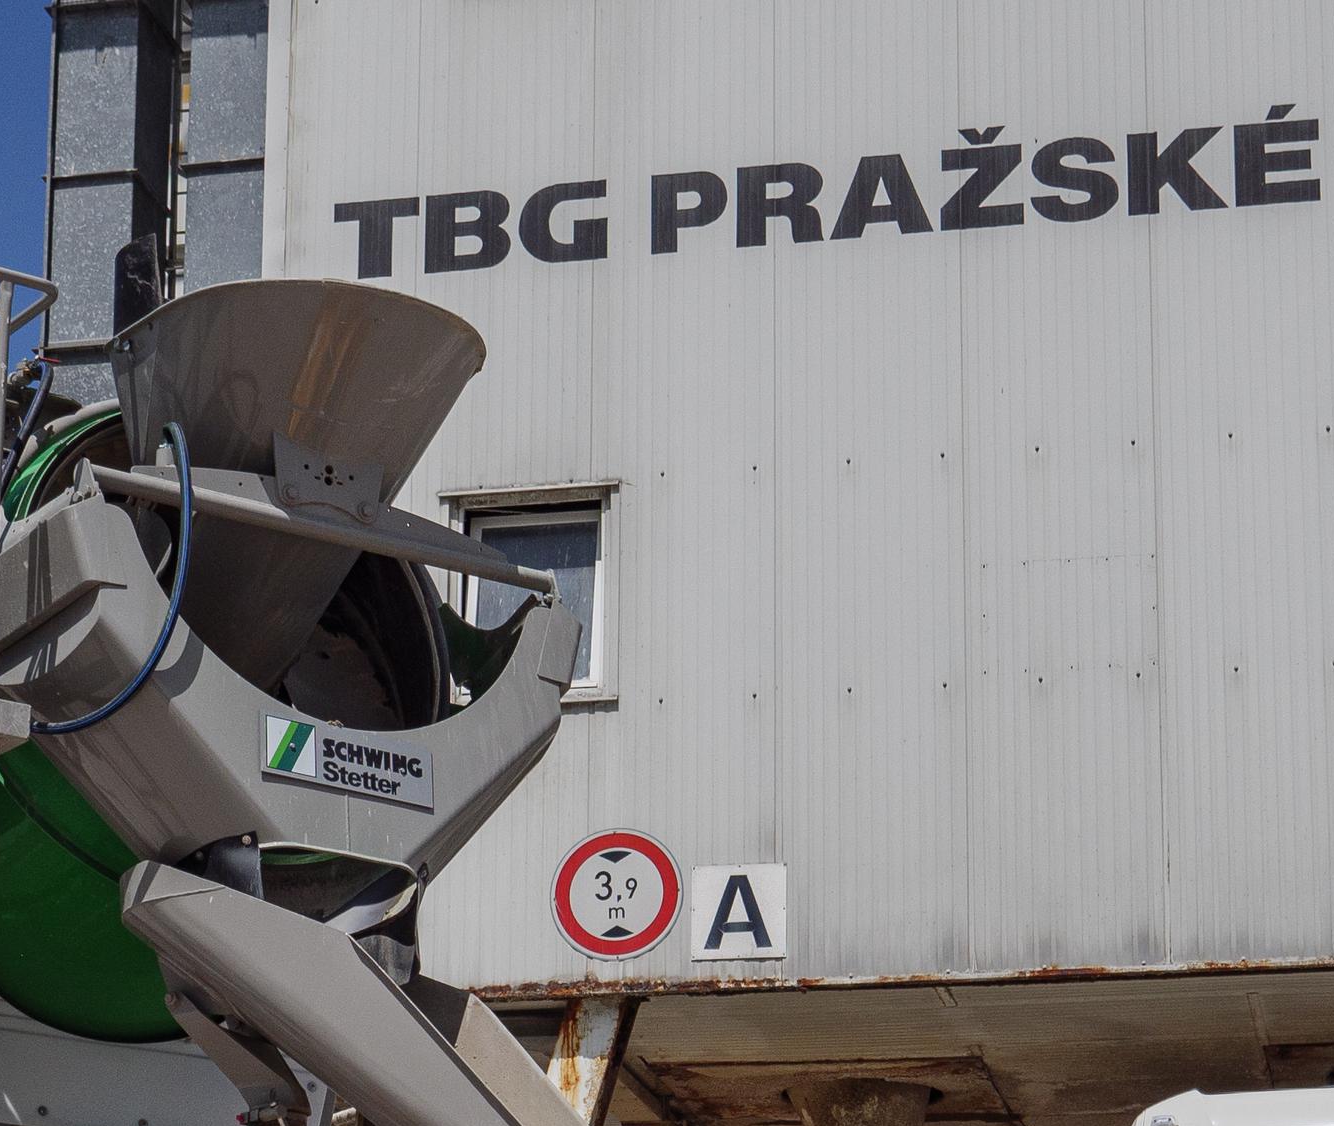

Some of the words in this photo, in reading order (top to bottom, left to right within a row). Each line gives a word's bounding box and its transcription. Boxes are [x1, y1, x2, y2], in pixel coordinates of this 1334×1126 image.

[334, 180, 609, 280] TBG
[651, 103, 1322, 255] PRAŽSKÉ
[322, 738, 423, 779] SCHWING
[322, 761, 401, 796] Stetter
[594, 870, 638, 903] 3,9
[608, 906, 626, 920] m
[703, 874, 773, 950] A
